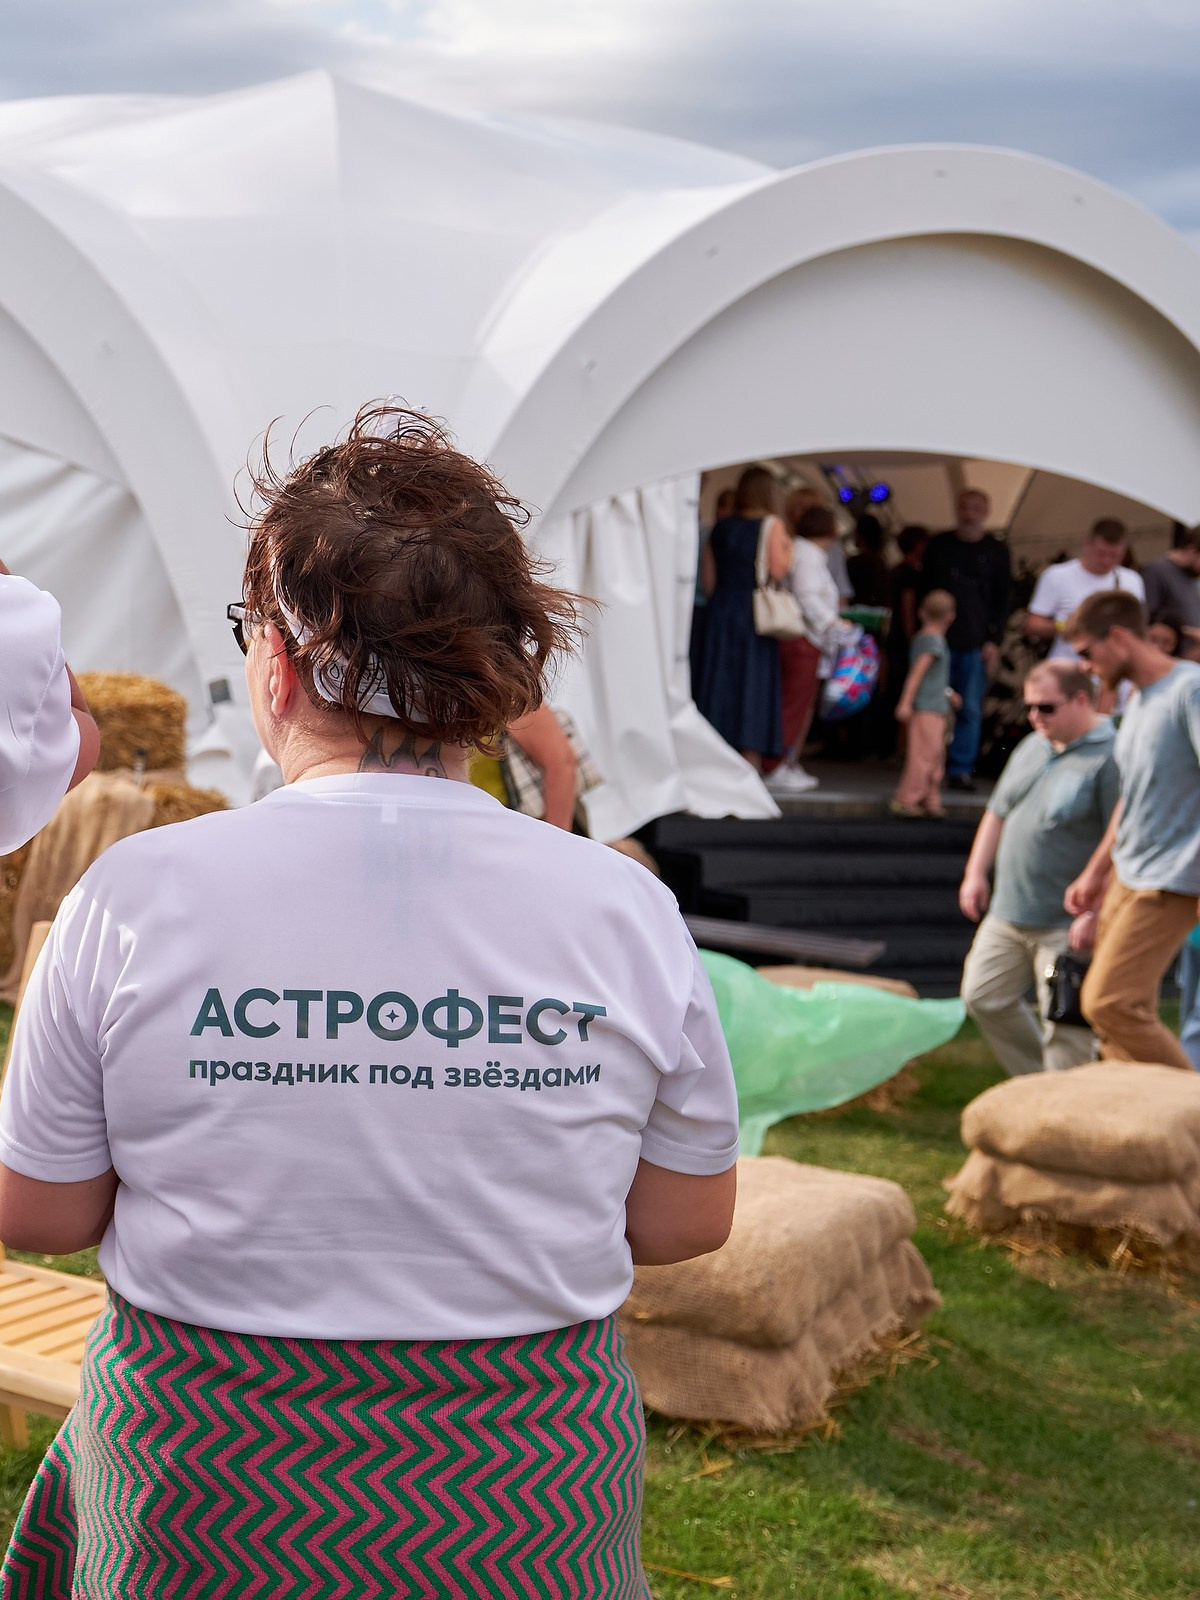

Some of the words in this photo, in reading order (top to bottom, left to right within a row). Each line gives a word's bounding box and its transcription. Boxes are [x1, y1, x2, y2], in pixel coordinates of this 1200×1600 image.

[189, 987, 608, 1049] АСТРОФЕСТ
[189, 1059, 360, 1087] праздник
[369, 1064, 435, 1090] под
[443, 1060, 602, 1092] звёздами
